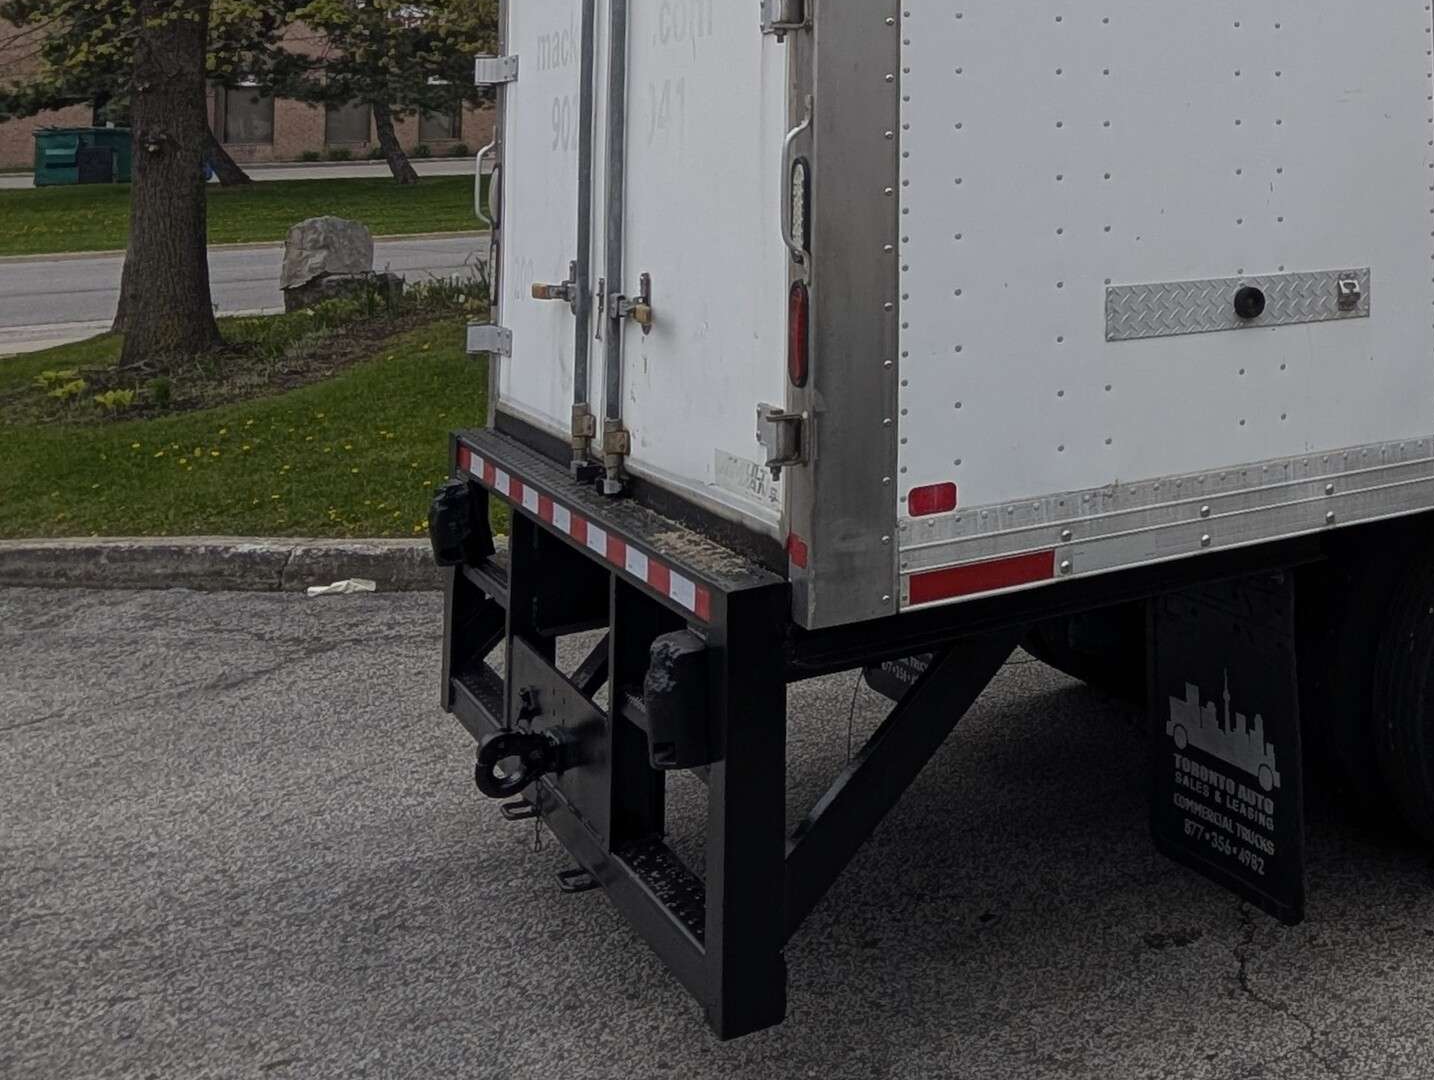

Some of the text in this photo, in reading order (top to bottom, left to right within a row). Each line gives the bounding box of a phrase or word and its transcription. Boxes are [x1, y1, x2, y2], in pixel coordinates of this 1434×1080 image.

[1173, 753, 1274, 815] TORONTO AUTO
[1175, 771, 1274, 832] SALES & LEASING
[1173, 792, 1275, 856] COMMERCIAL TRUCKS
